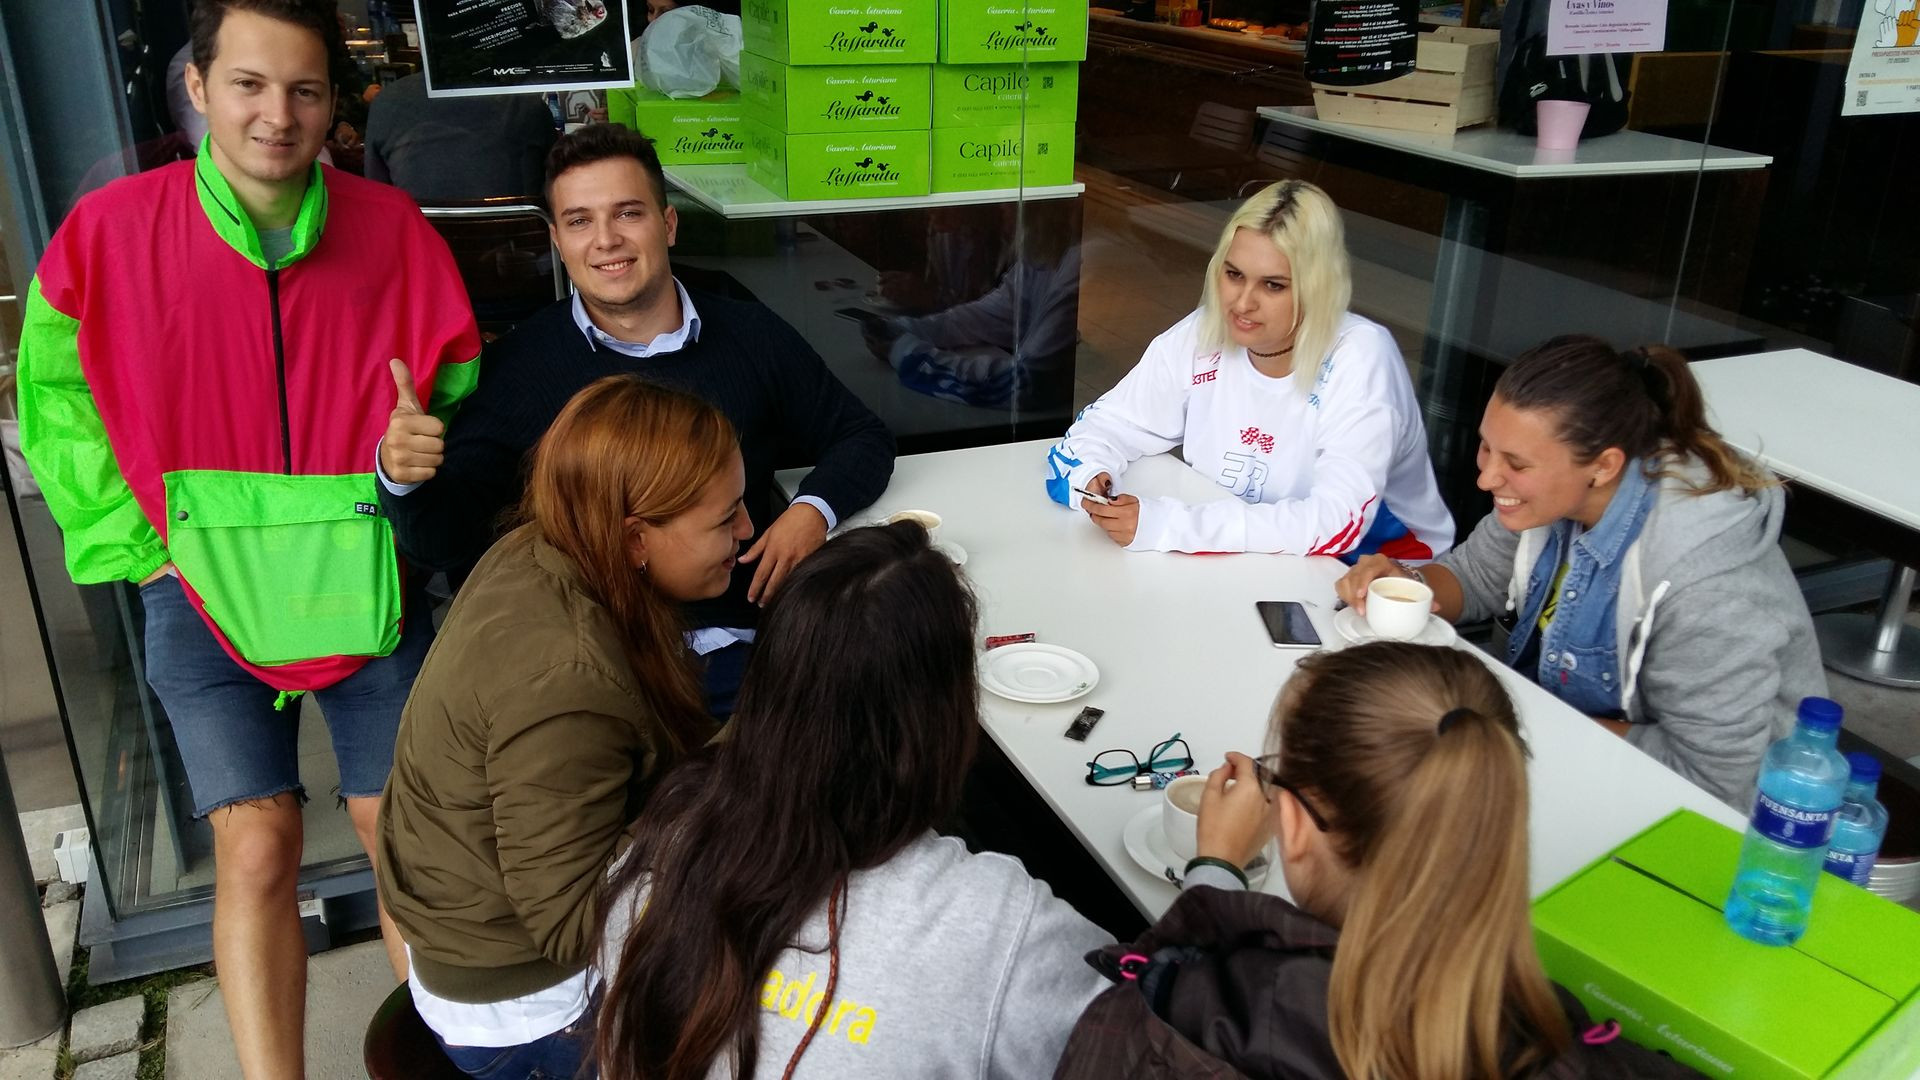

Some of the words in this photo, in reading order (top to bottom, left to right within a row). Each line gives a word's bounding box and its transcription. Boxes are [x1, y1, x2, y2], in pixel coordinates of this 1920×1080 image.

[1021, 6, 1056, 16] Aturiana
[356, 503, 376, 514] EFA
[1760, 793, 1830, 822] FUENSANTA
